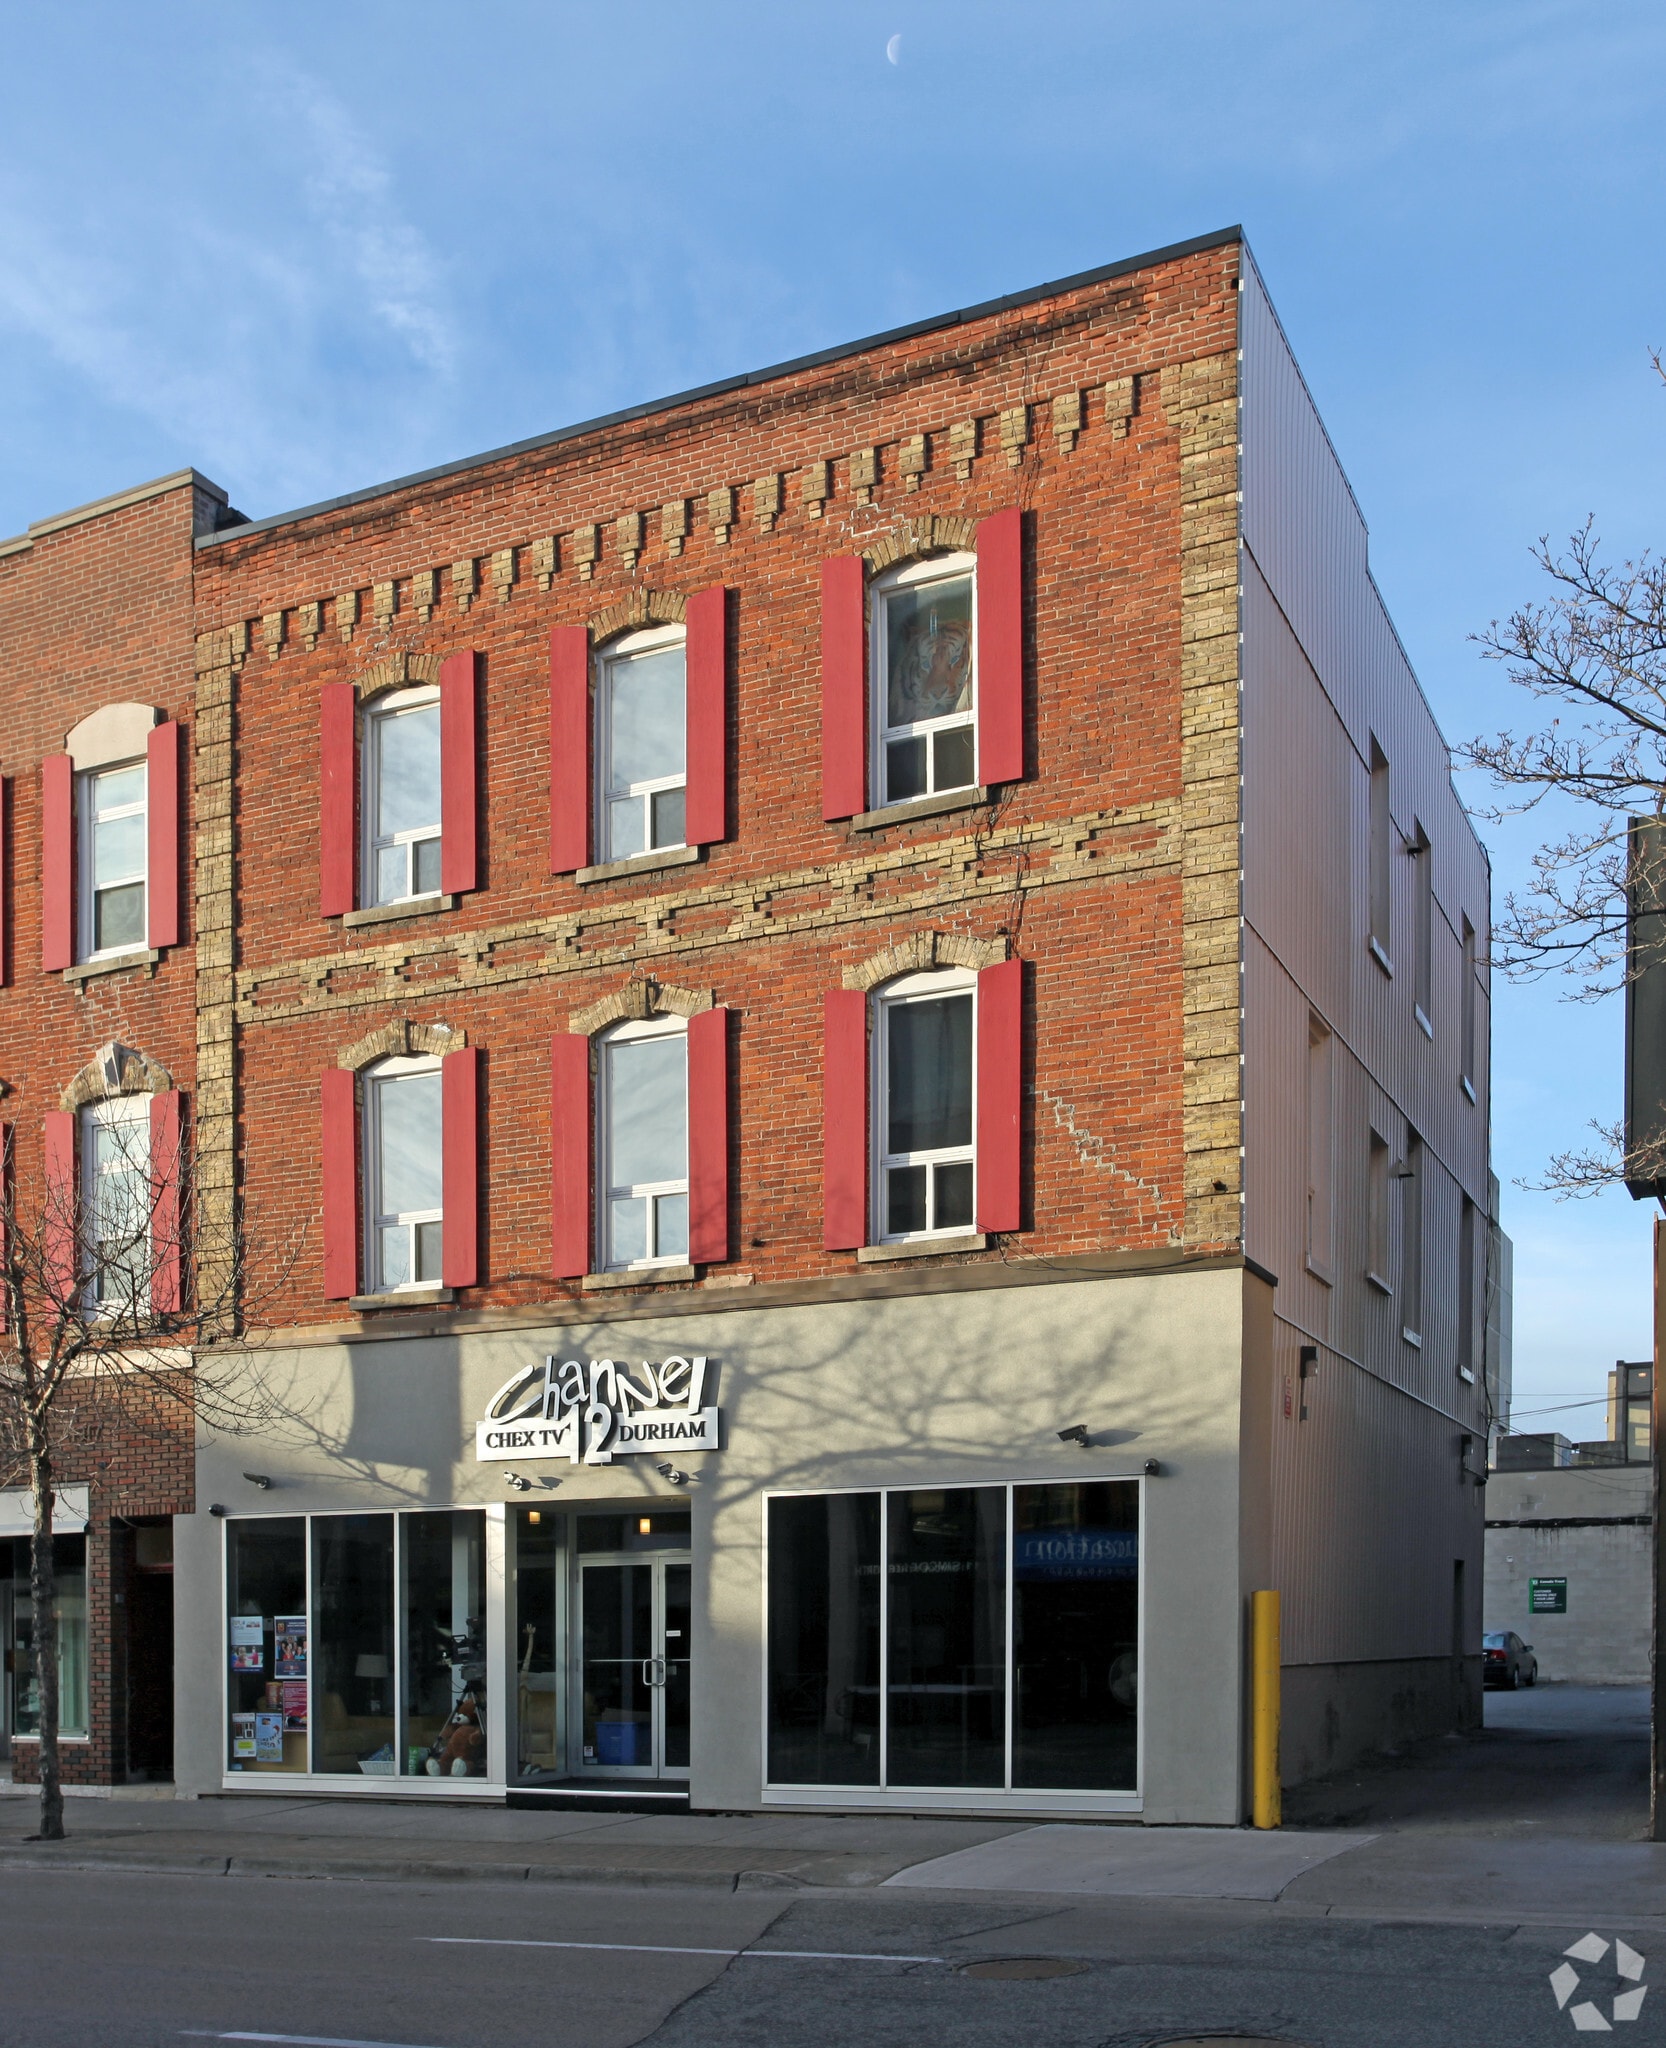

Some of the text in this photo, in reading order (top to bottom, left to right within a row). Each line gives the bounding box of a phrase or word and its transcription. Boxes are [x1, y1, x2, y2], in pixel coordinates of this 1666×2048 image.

[485, 1429, 565, 1449] CHEX TV
[562, 1402, 613, 1464] 12
[618, 1421, 706, 1442] DURHAM
